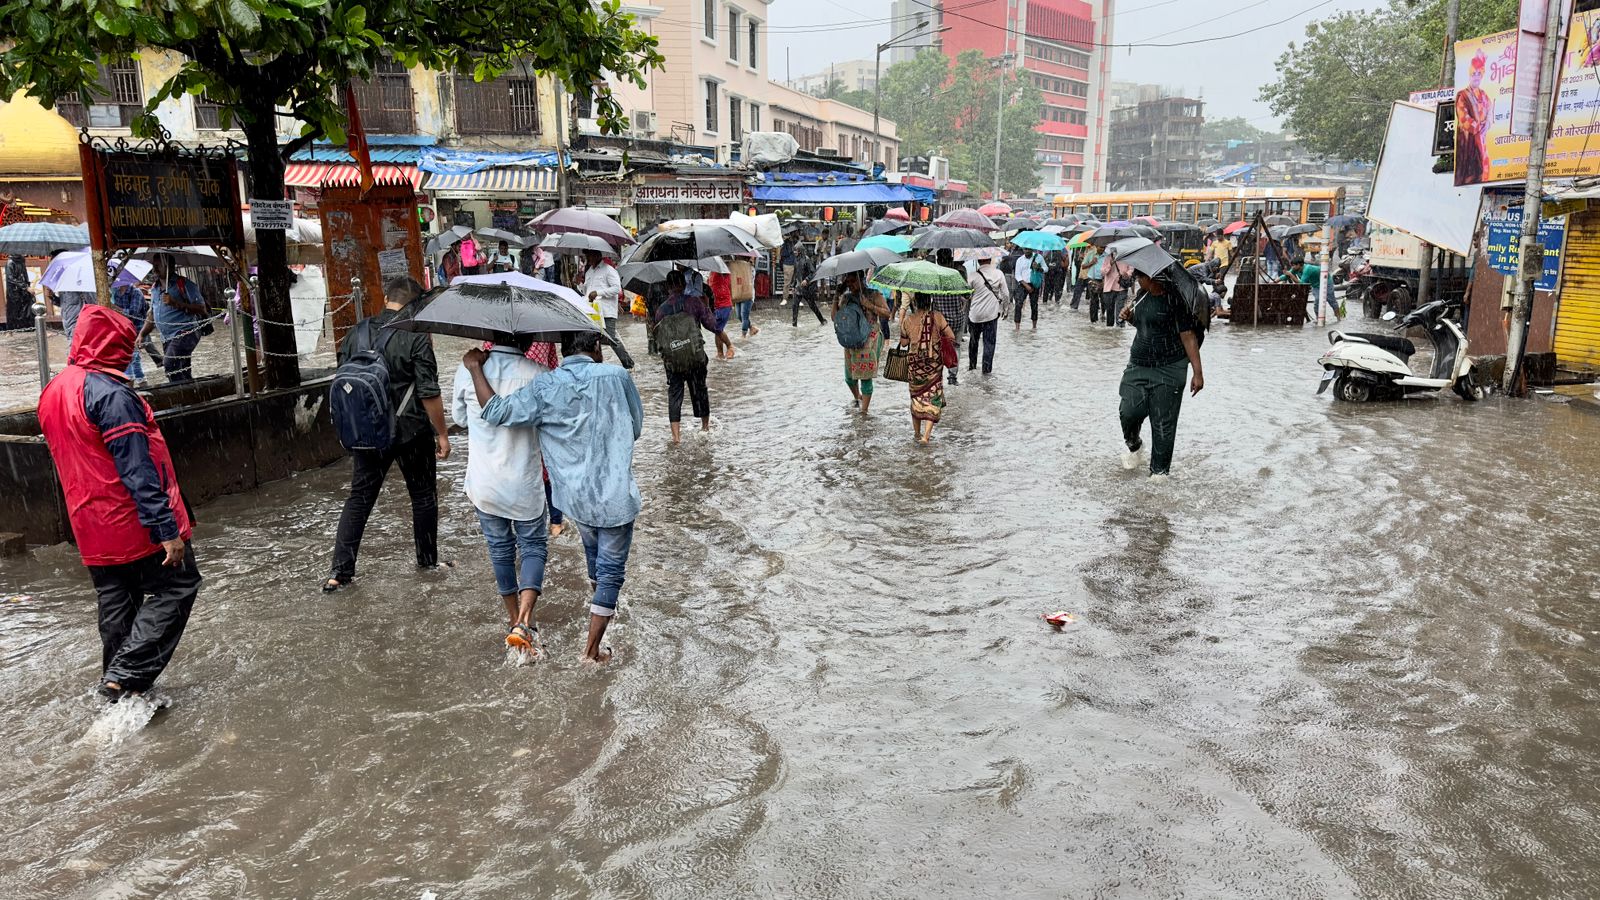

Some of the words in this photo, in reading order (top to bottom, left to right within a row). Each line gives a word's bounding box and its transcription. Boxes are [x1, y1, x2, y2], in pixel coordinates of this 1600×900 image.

[1437, 88, 1455, 98] POLICE
[588, 188, 618, 196] FLORIST
[636, 186, 679, 199] आराधना
[718, 182, 740, 200] स्टोर
[110, 205, 160, 228] MEHMOOD
[162, 207, 200, 227] DURRANI
[202, 207, 231, 227] CHOWK
